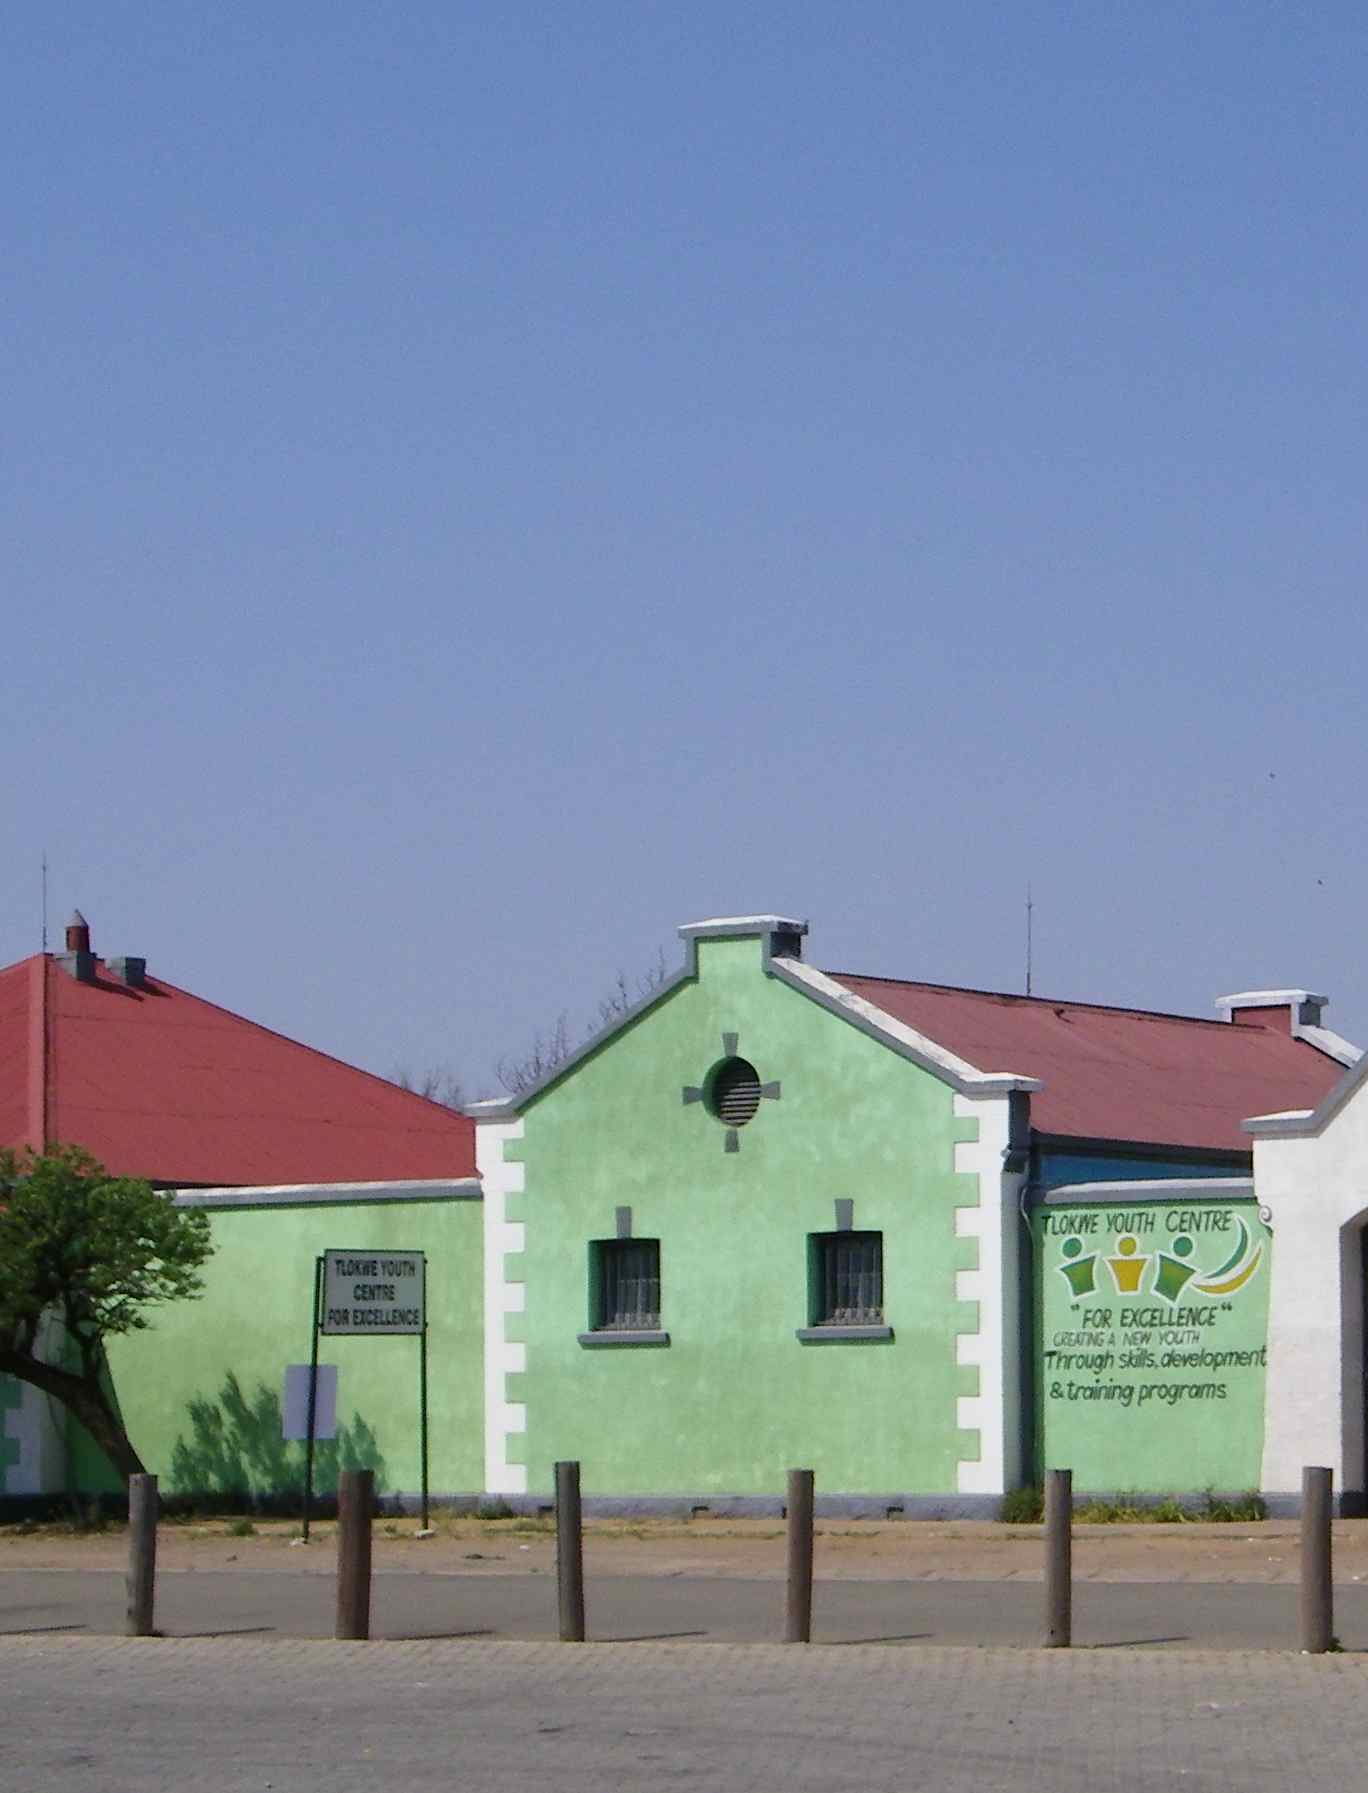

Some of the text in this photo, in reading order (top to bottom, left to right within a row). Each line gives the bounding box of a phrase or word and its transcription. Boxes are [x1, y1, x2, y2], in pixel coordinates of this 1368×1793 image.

[1042, 1210, 1233, 1235] TLOKWE YOUTH CENTRE
[336, 1259, 416, 1277] TLOKWE YOUTH
[353, 1284, 395, 1301] CENTRE
[328, 1308, 419, 1325] FOR EXCELLENCE
[1053, 1330, 1200, 1347] CREATING A NEW YOUTH
[1044, 1351, 1114, 1375] Through
[1161, 1346, 1267, 1371] development
[1066, 1378, 1134, 1407] training
[1137, 1382, 1227, 1407] programs
